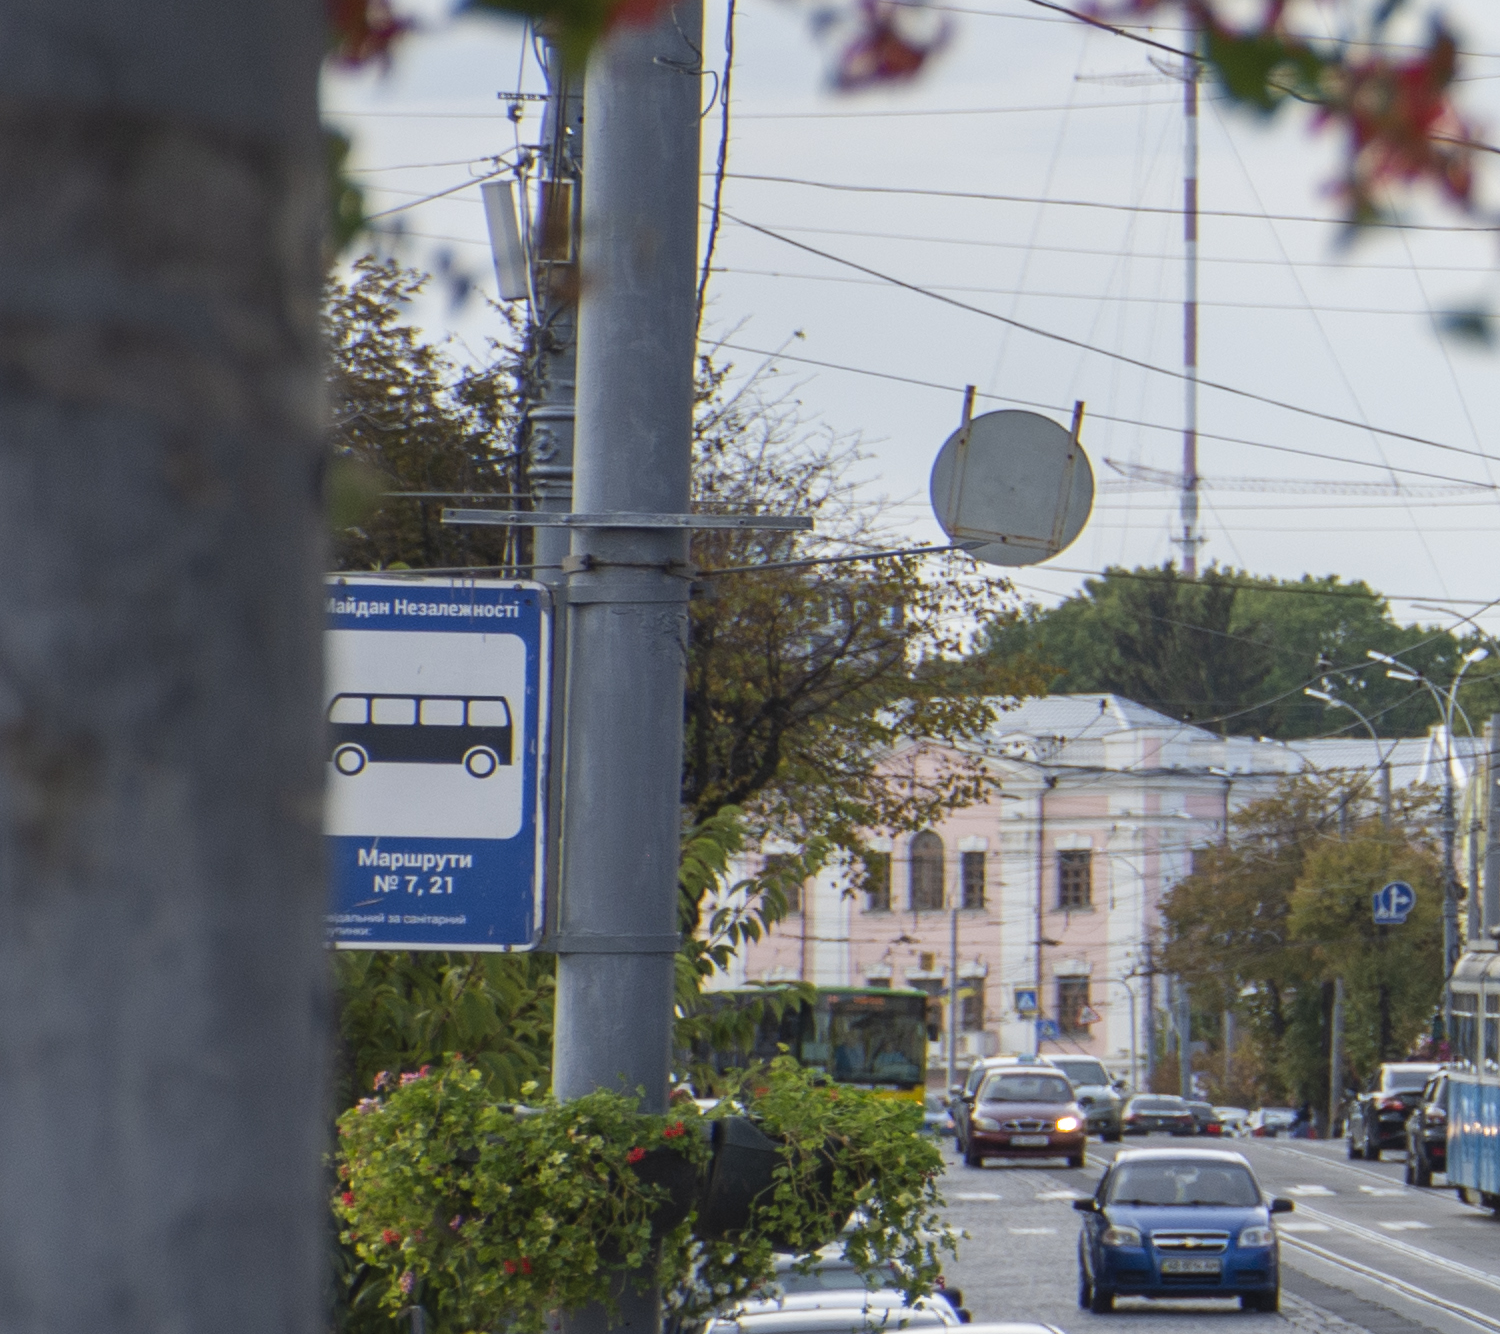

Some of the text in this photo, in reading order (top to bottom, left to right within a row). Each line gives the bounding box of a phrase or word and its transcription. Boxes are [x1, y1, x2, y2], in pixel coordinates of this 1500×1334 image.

[394, 599, 520, 618] Незалежності
[358, 848, 473, 871] Маршрути
[404, 875, 423, 897] 7,
[429, 876, 453, 894] 21
